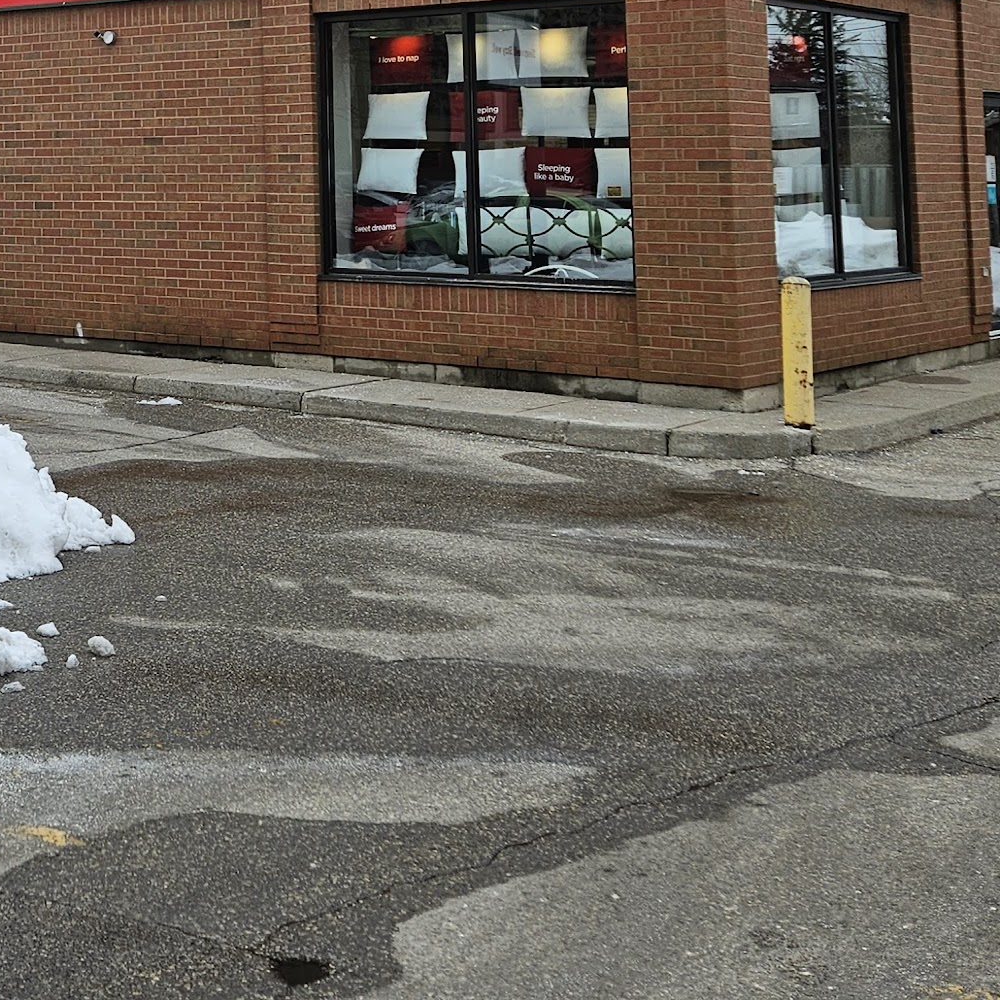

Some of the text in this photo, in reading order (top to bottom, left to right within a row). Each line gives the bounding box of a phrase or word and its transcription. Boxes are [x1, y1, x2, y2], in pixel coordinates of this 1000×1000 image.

[406, 55, 420, 63] nap
[477, 115, 496, 123] auty
[537, 163, 571, 174] Sleeping
[534, 172, 547, 181] like
[554, 173, 575, 183] baby
[354, 223, 397, 233] Sweet dreams
